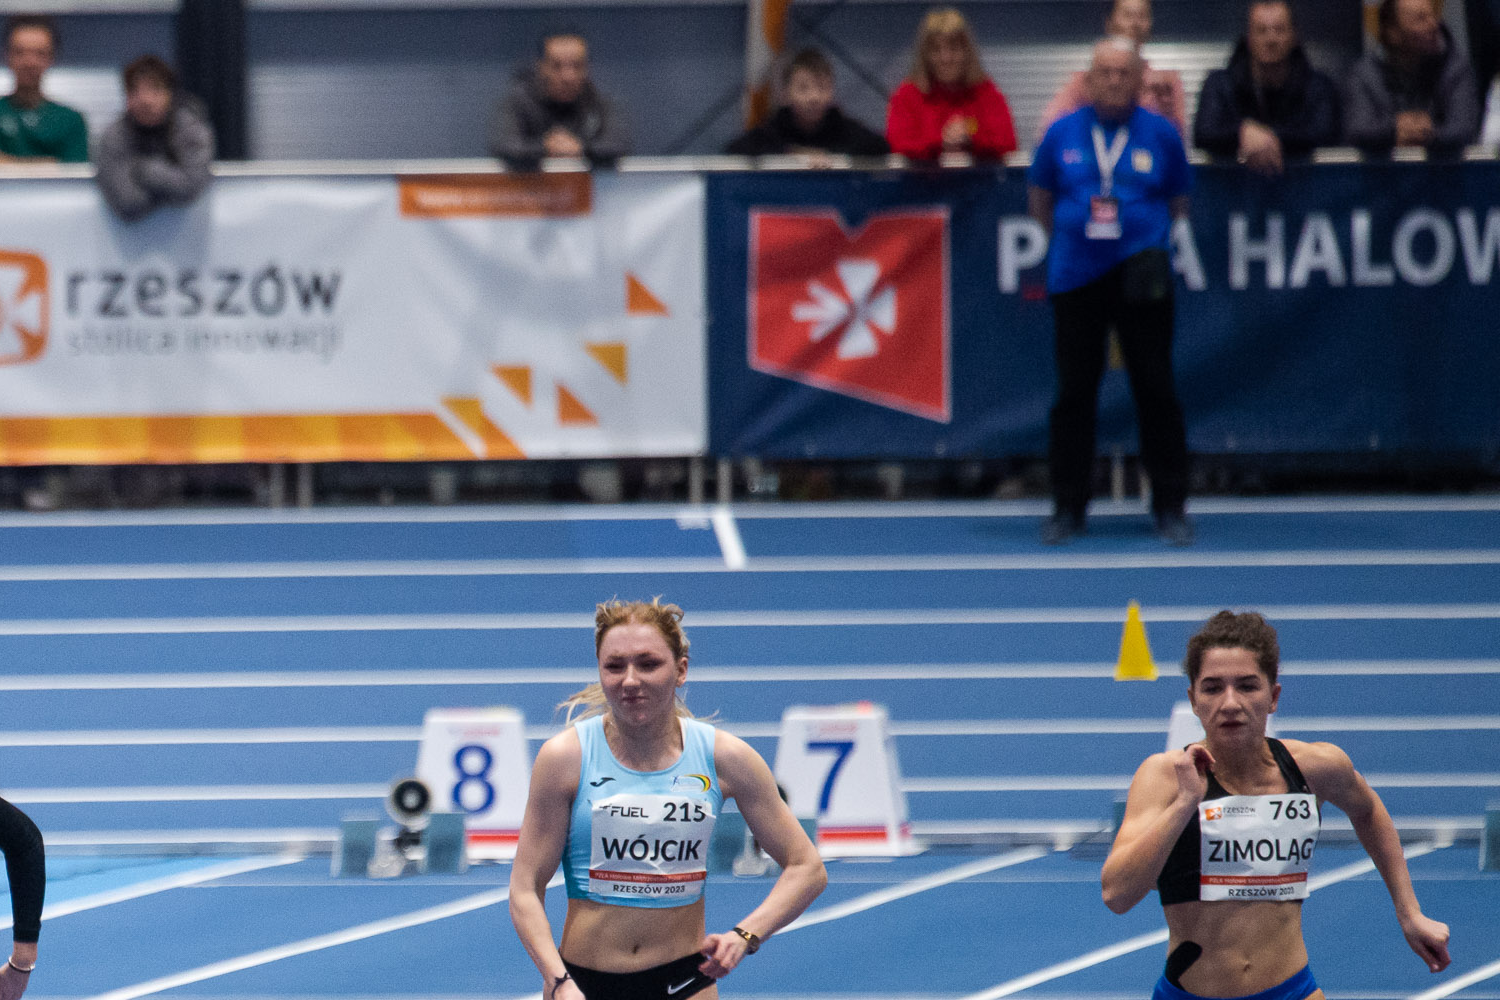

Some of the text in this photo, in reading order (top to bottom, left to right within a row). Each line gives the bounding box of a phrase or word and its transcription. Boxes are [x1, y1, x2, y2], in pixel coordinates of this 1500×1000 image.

[998, 215, 1206, 292] PA
[66, 260, 342, 318] rzeszów
[452, 744, 496, 817] 8
[806, 740, 856, 815] 7
[610, 806, 649, 818] FUEL
[663, 802, 706, 822] 215
[1269, 800, 1311, 820] 763
[602, 834, 702, 862] WÓJCIK
[1208, 838, 1314, 865] ZIMOLĄG
[613, 884, 685, 894] RZESZÓW 2023
[1228, 886, 1277, 896] RZESZÓW
